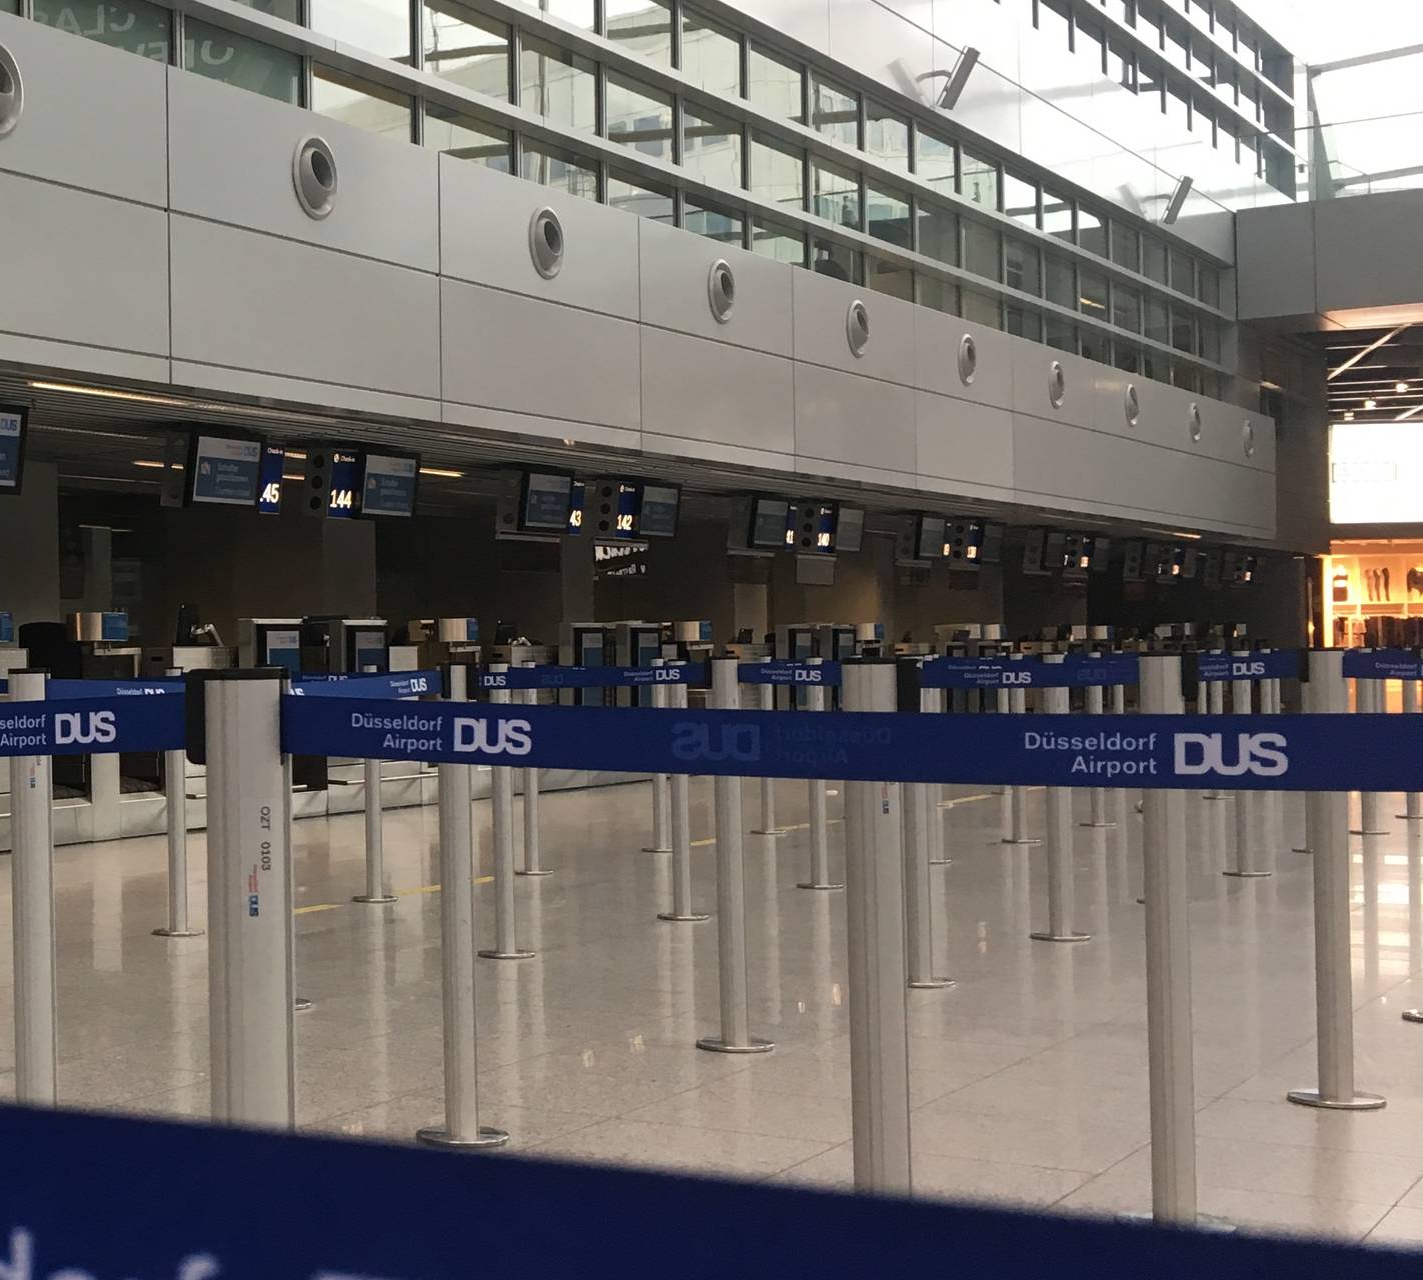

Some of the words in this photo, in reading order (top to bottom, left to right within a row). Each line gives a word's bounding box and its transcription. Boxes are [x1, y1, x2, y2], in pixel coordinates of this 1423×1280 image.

[259, 483, 279, 504] 45
[329, 490, 353, 508] 144
[569, 510, 582, 527] 43
[616, 514, 632, 531] 142
[656, 669, 680, 680] DUS
[795, 669, 821, 682] DUS
[1002, 672, 1031, 684] DUS
[1233, 662, 1265, 675] DUS
[410, 678, 427, 692] DUS
[484, 675, 506, 686] DUS
[55, 711, 116, 745] DUS
[351, 713, 443, 732] Düsseldorf
[0, 732, 47, 749] Airport
[383, 734, 442, 753] Airport
[453, 717, 532, 755] DUS
[1024, 732, 1157, 752] Düsseldorf
[1174, 732, 1288, 776] DUS
[1071, 755, 1157, 778] Airport
[260, 806, 271, 830] OZT
[261, 841, 271, 871] 0103
[249, 895, 259, 917] DUS
